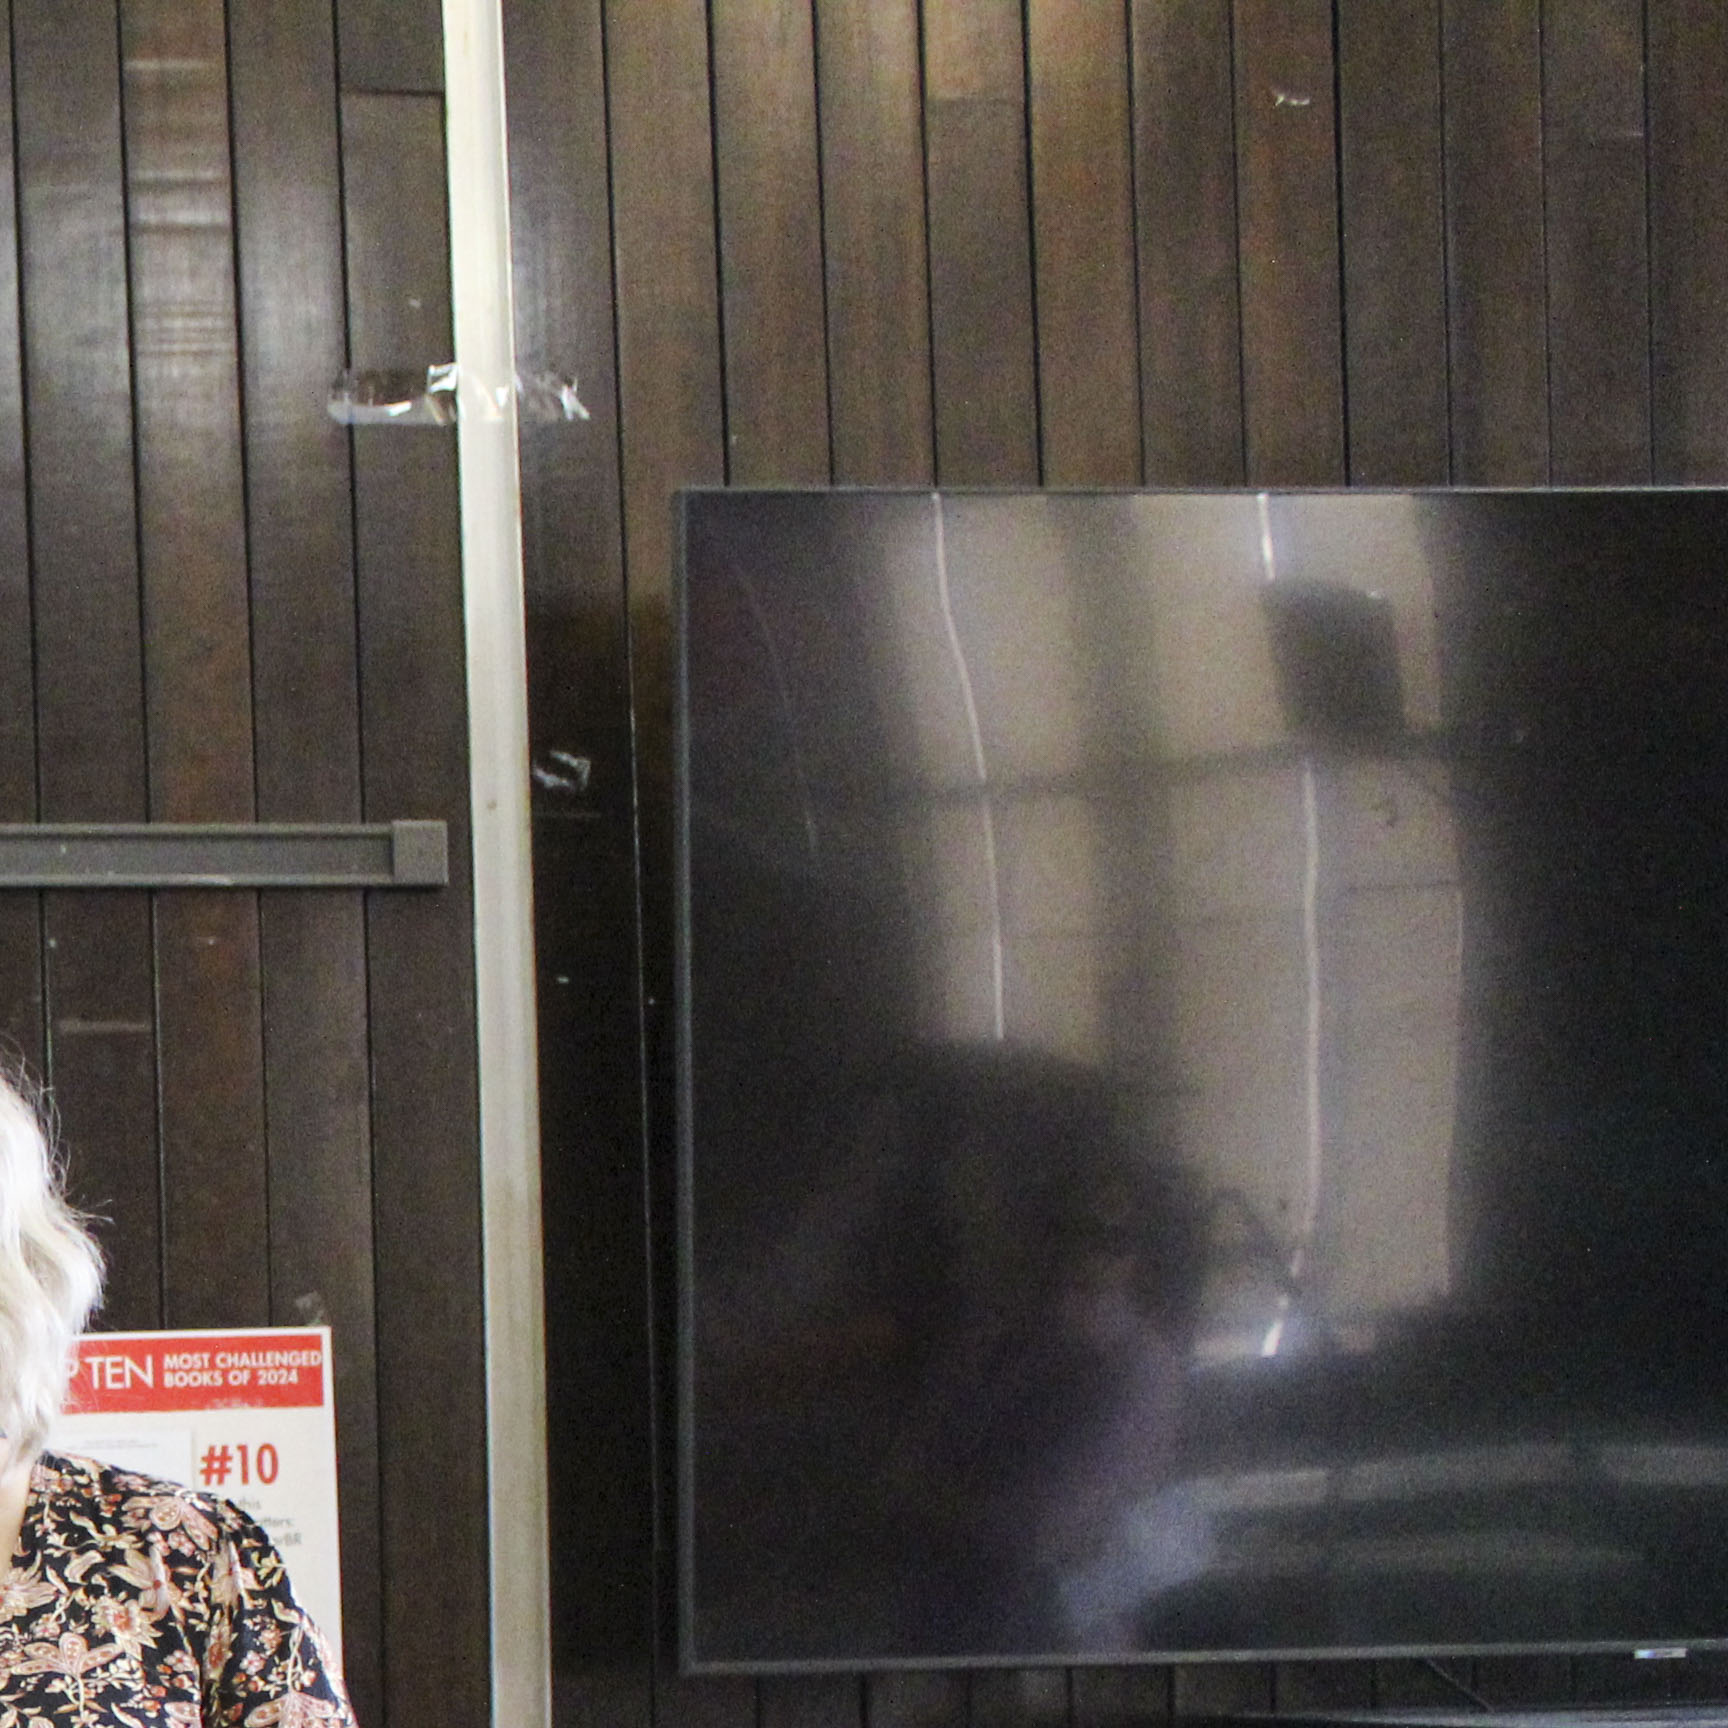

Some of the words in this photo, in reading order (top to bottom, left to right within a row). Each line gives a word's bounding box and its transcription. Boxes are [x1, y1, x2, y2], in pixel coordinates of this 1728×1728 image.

[84, 1356, 155, 1389] TEN
[164, 1352, 210, 1370] MOST
[215, 1350, 322, 1368] CHALLENGED
[164, 1371, 223, 1388] BOOKS
[228, 1370, 253, 1386] OF
[256, 1368, 298, 1385] 2024
[200, 1442, 280, 1486] #10
